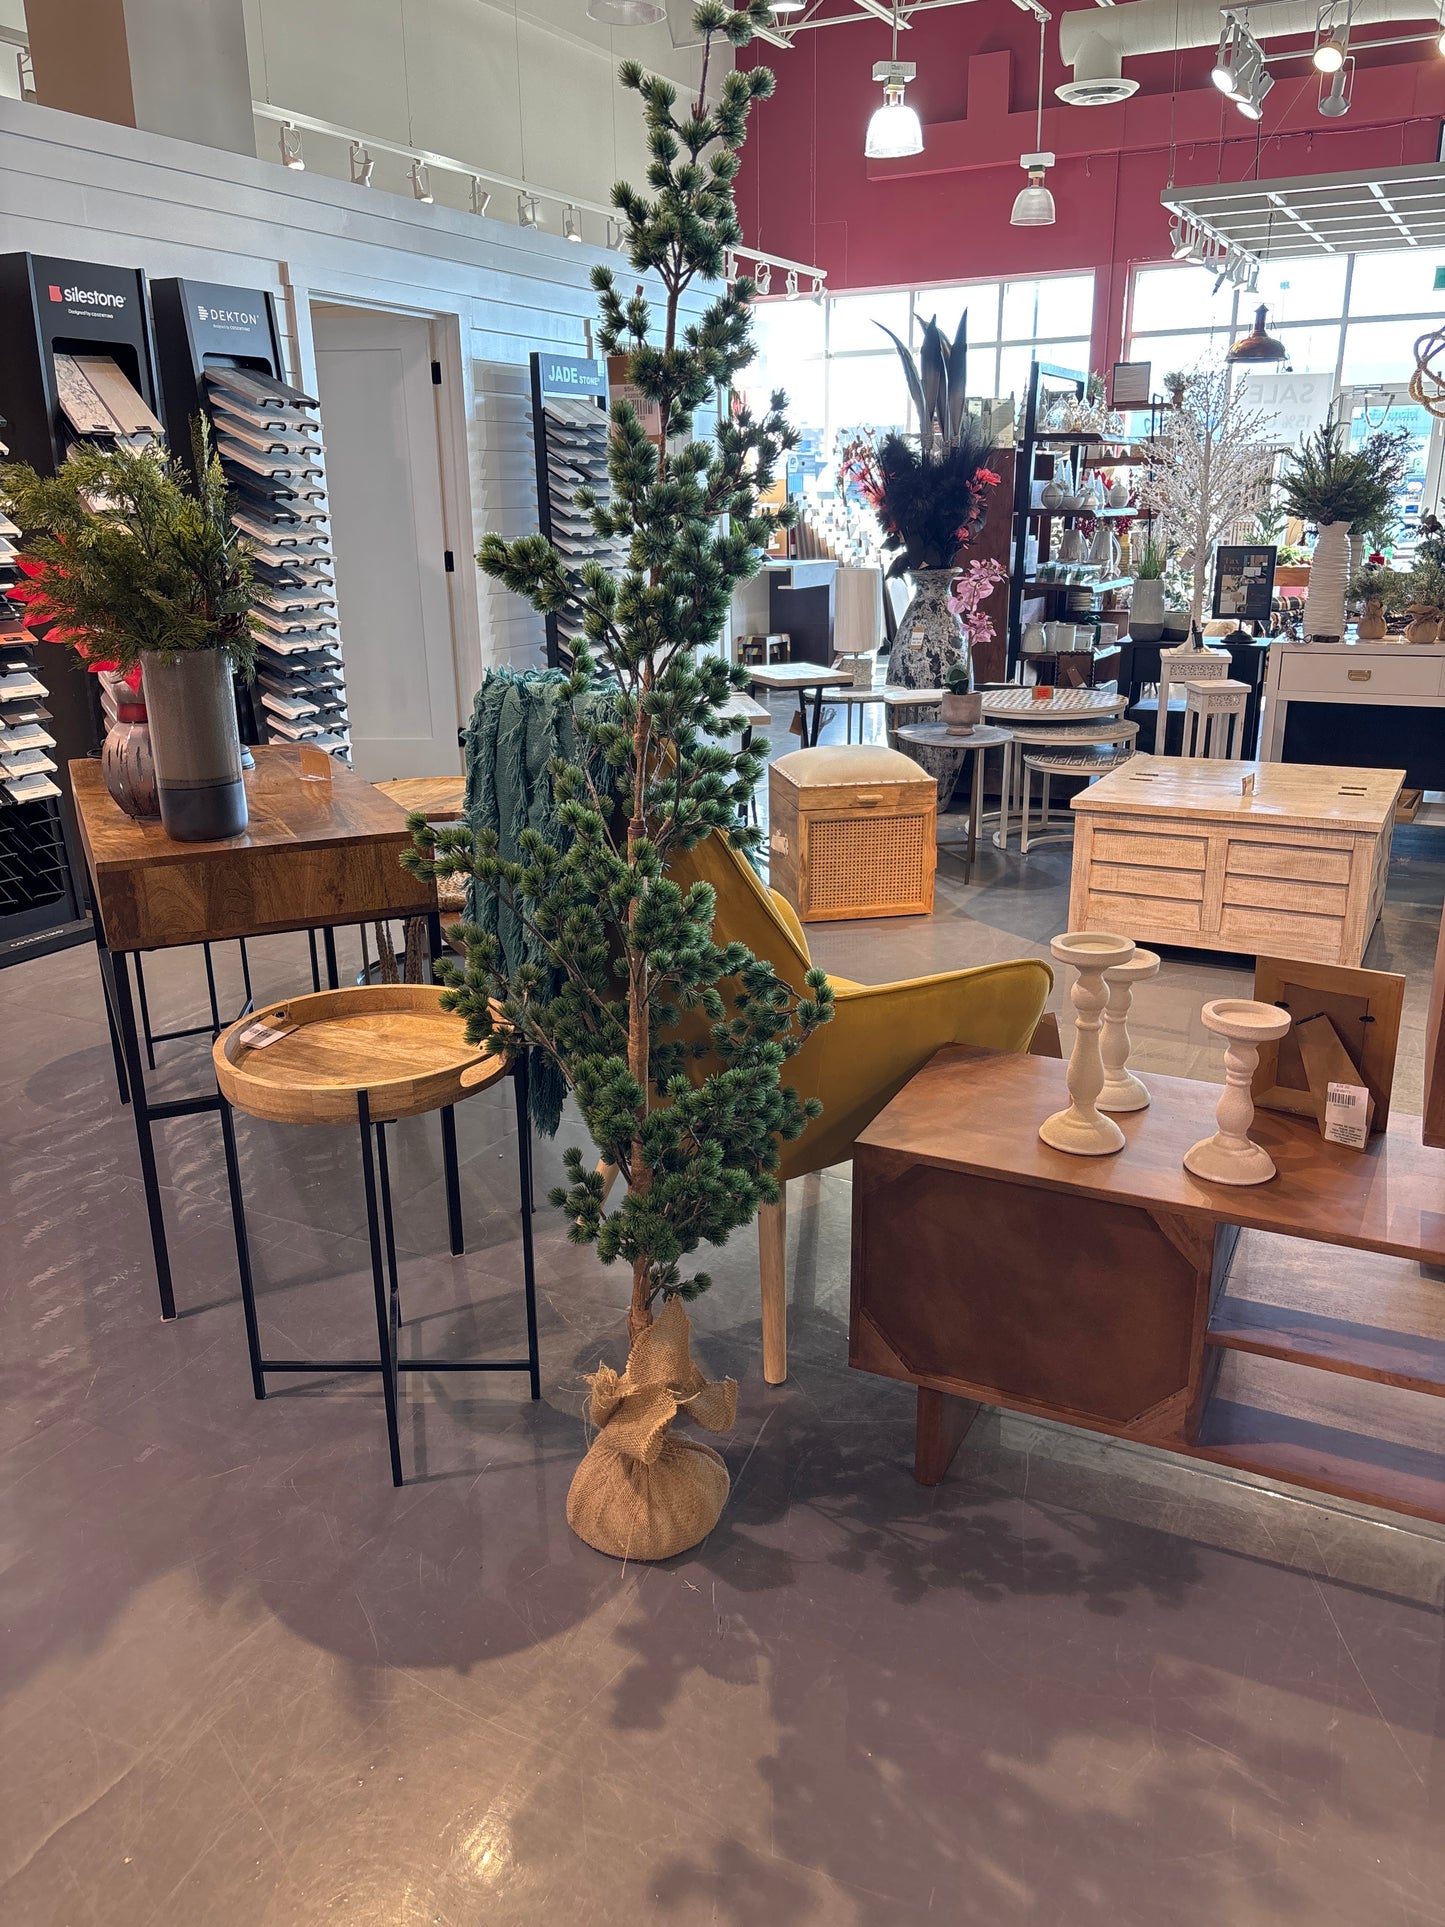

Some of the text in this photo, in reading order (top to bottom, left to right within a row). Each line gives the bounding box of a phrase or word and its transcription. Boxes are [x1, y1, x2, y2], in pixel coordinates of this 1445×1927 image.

[64, 287, 125, 308] silestone
[210, 309, 257, 325] DEKTON
[548, 365, 598, 386] JADE STONE
